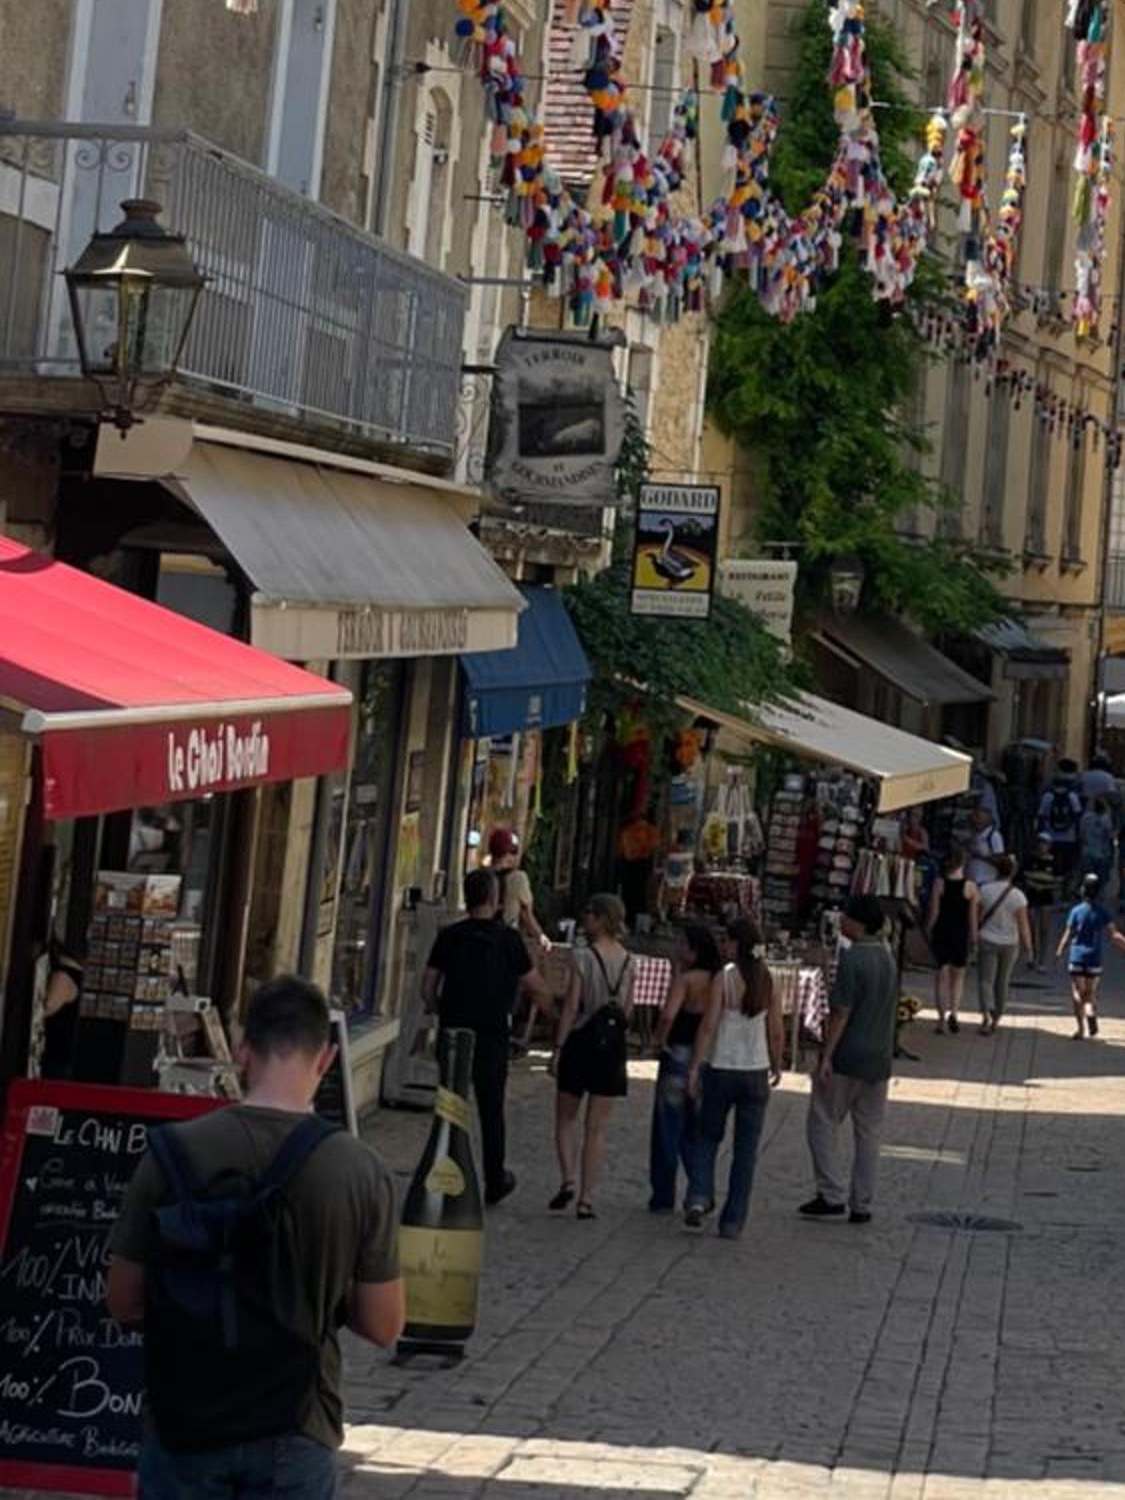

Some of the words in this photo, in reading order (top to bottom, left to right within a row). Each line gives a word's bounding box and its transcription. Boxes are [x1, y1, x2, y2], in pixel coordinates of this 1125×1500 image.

[525, 349, 586, 368] TERROIR
[640, 489, 715, 509] GODARD
[728, 571, 789, 581] RESTAURANT
